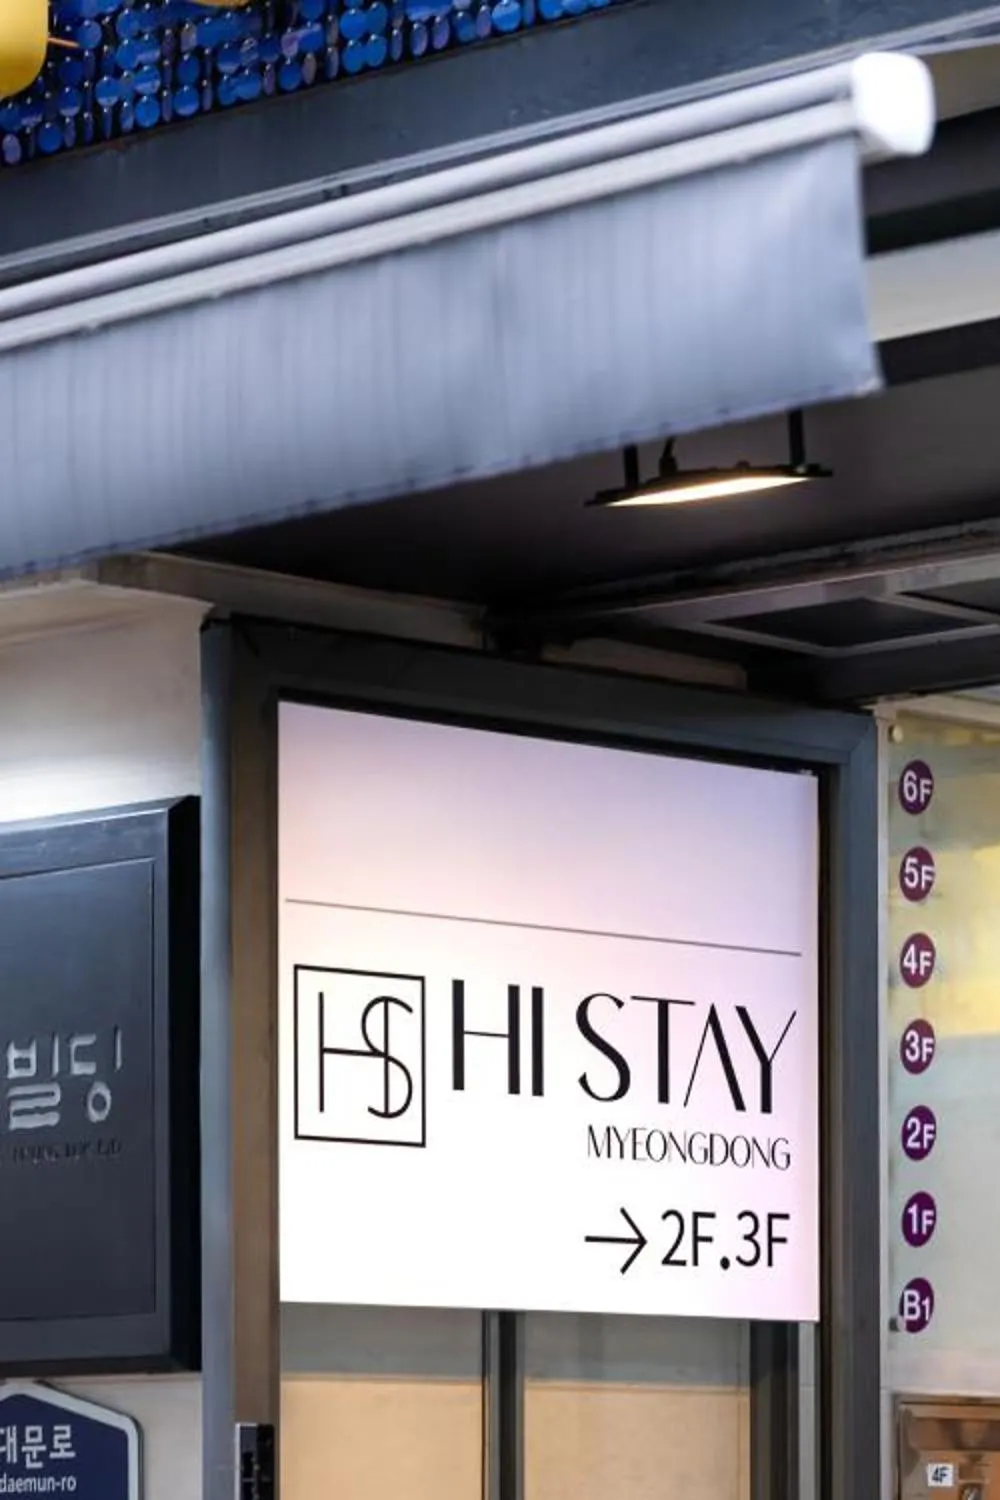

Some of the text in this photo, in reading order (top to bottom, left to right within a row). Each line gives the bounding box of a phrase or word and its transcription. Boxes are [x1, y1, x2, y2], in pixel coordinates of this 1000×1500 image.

[903, 771, 933, 804] 6F
[904, 856, 935, 889] 5F
[903, 944, 933, 975] 4F
[451, 978, 797, 1114] HI STAY
[904, 1032, 934, 1063] 3F
[7, 1029, 122, 1130] 빌딩
[587, 1125, 792, 1171] MYEONGDONG
[906, 1118, 936, 1149] 2F
[907, 1203, 935, 1235] 1F
[660, 1209, 791, 1270] 2F.3F
[903, 1290, 931, 1321] B1
[931, 1466, 948, 1483] 4F
